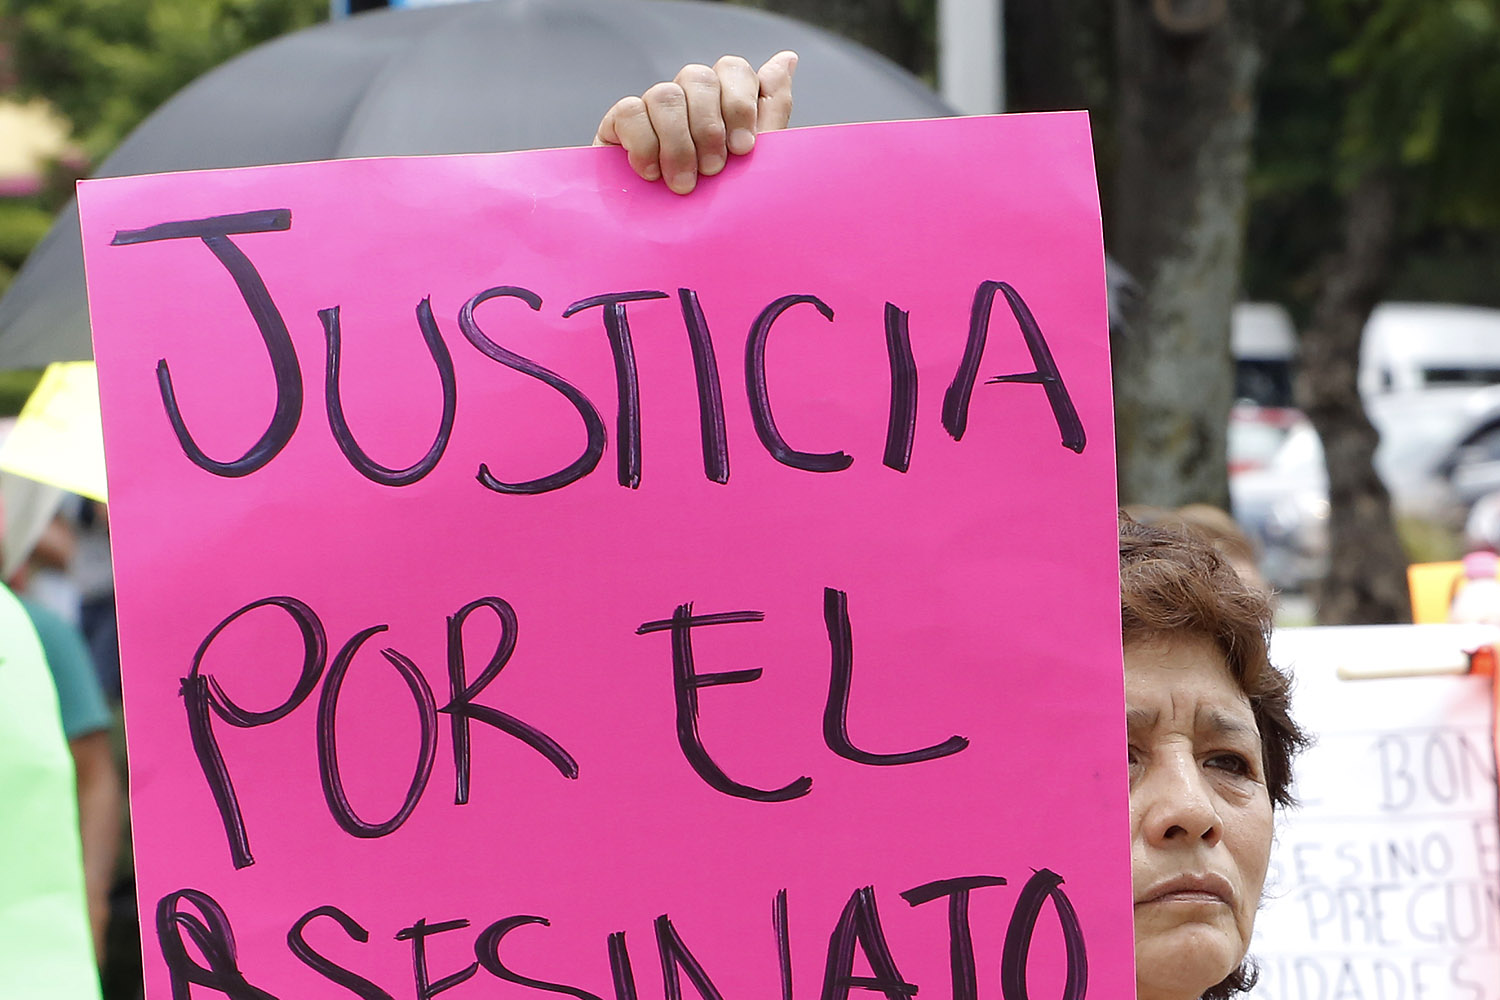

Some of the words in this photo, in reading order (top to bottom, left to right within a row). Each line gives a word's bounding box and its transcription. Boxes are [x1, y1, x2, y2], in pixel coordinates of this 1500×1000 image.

[109, 207, 1088, 495] JUSTICIA
[178, 594, 580, 870] POR
[635, 586, 970, 802] EL
